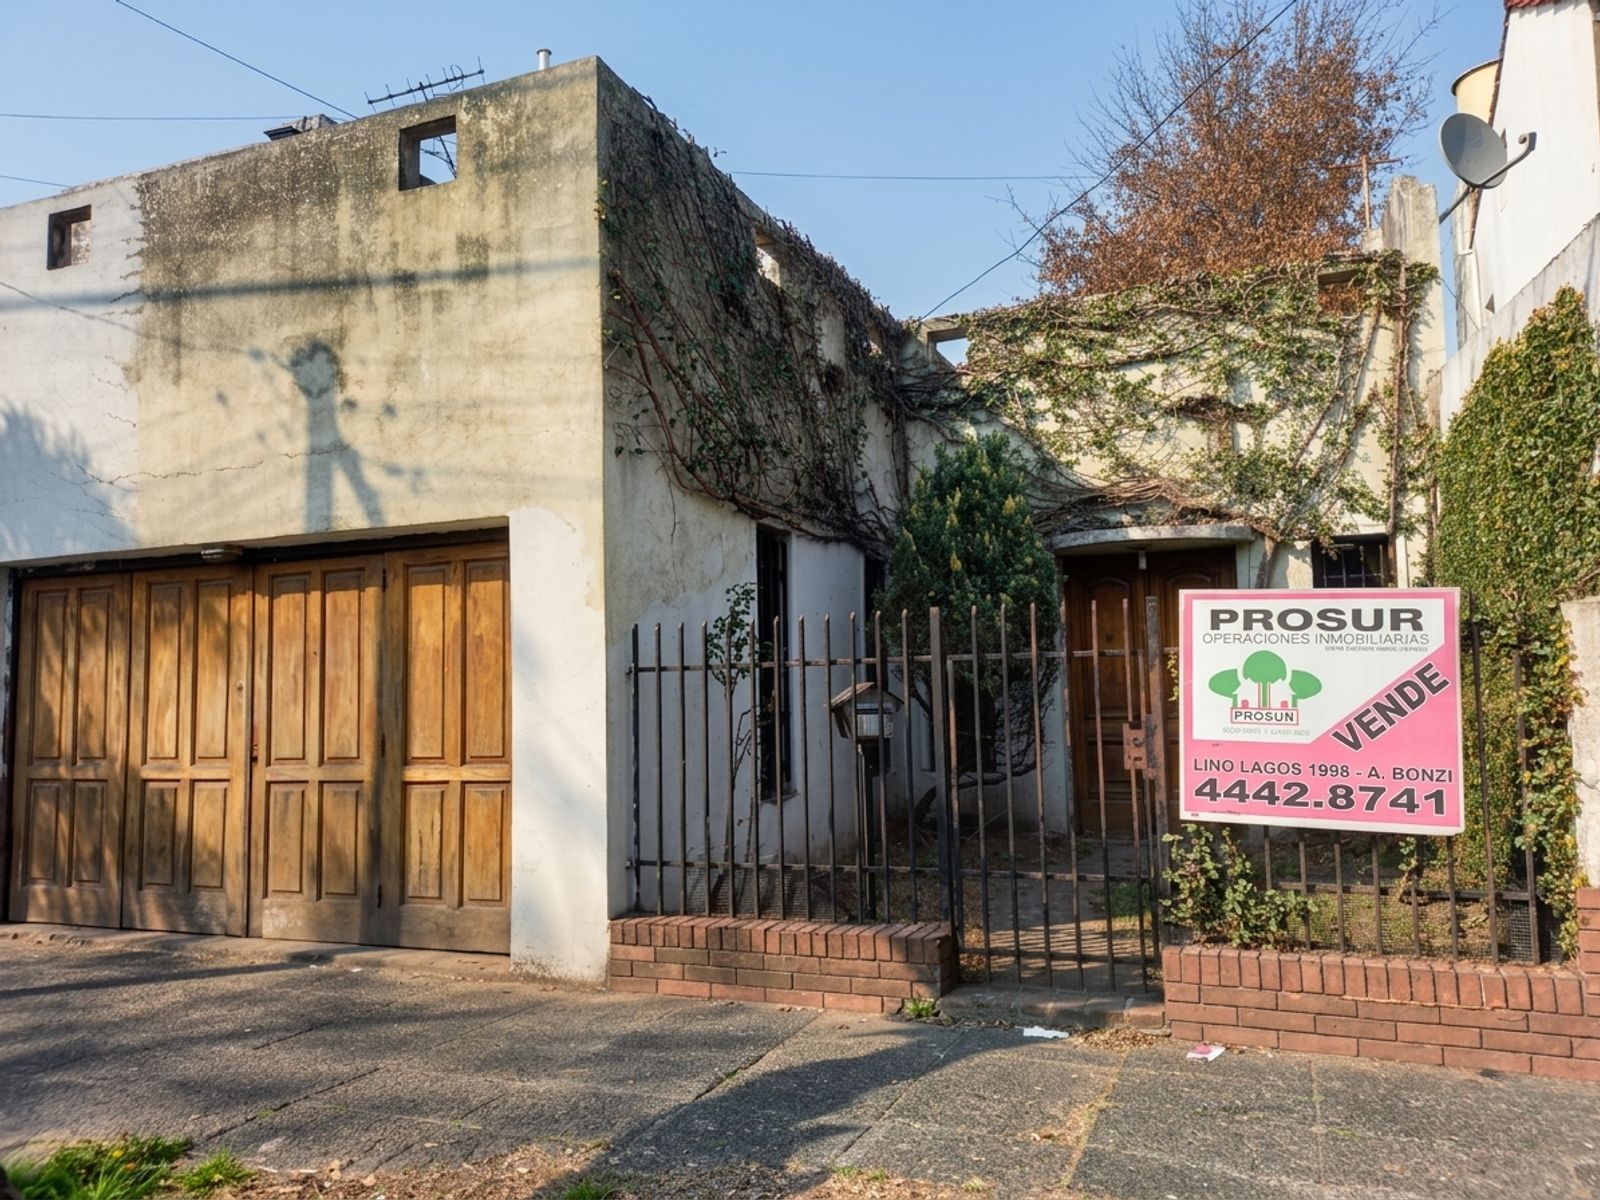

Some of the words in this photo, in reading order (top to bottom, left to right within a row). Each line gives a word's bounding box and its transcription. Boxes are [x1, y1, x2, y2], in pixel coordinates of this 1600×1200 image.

[1210, 608, 1423, 631] PROSUR
[1202, 633, 1310, 645] OPERACIONES
[1315, 633, 1430, 645] INMOBILIARIAS
[1234, 711, 1294, 722] PROSUN
[1331, 662, 1450, 752] VENDE
[1193, 758, 1235, 773] LINO
[1240, 761, 1302, 776] LAGOS
[1308, 764, 1350, 778] 1998
[1367, 767, 1385, 780] A.
[1392, 768, 1453, 783] BONZI
[1194, 778, 1446, 815] 4442.8741
